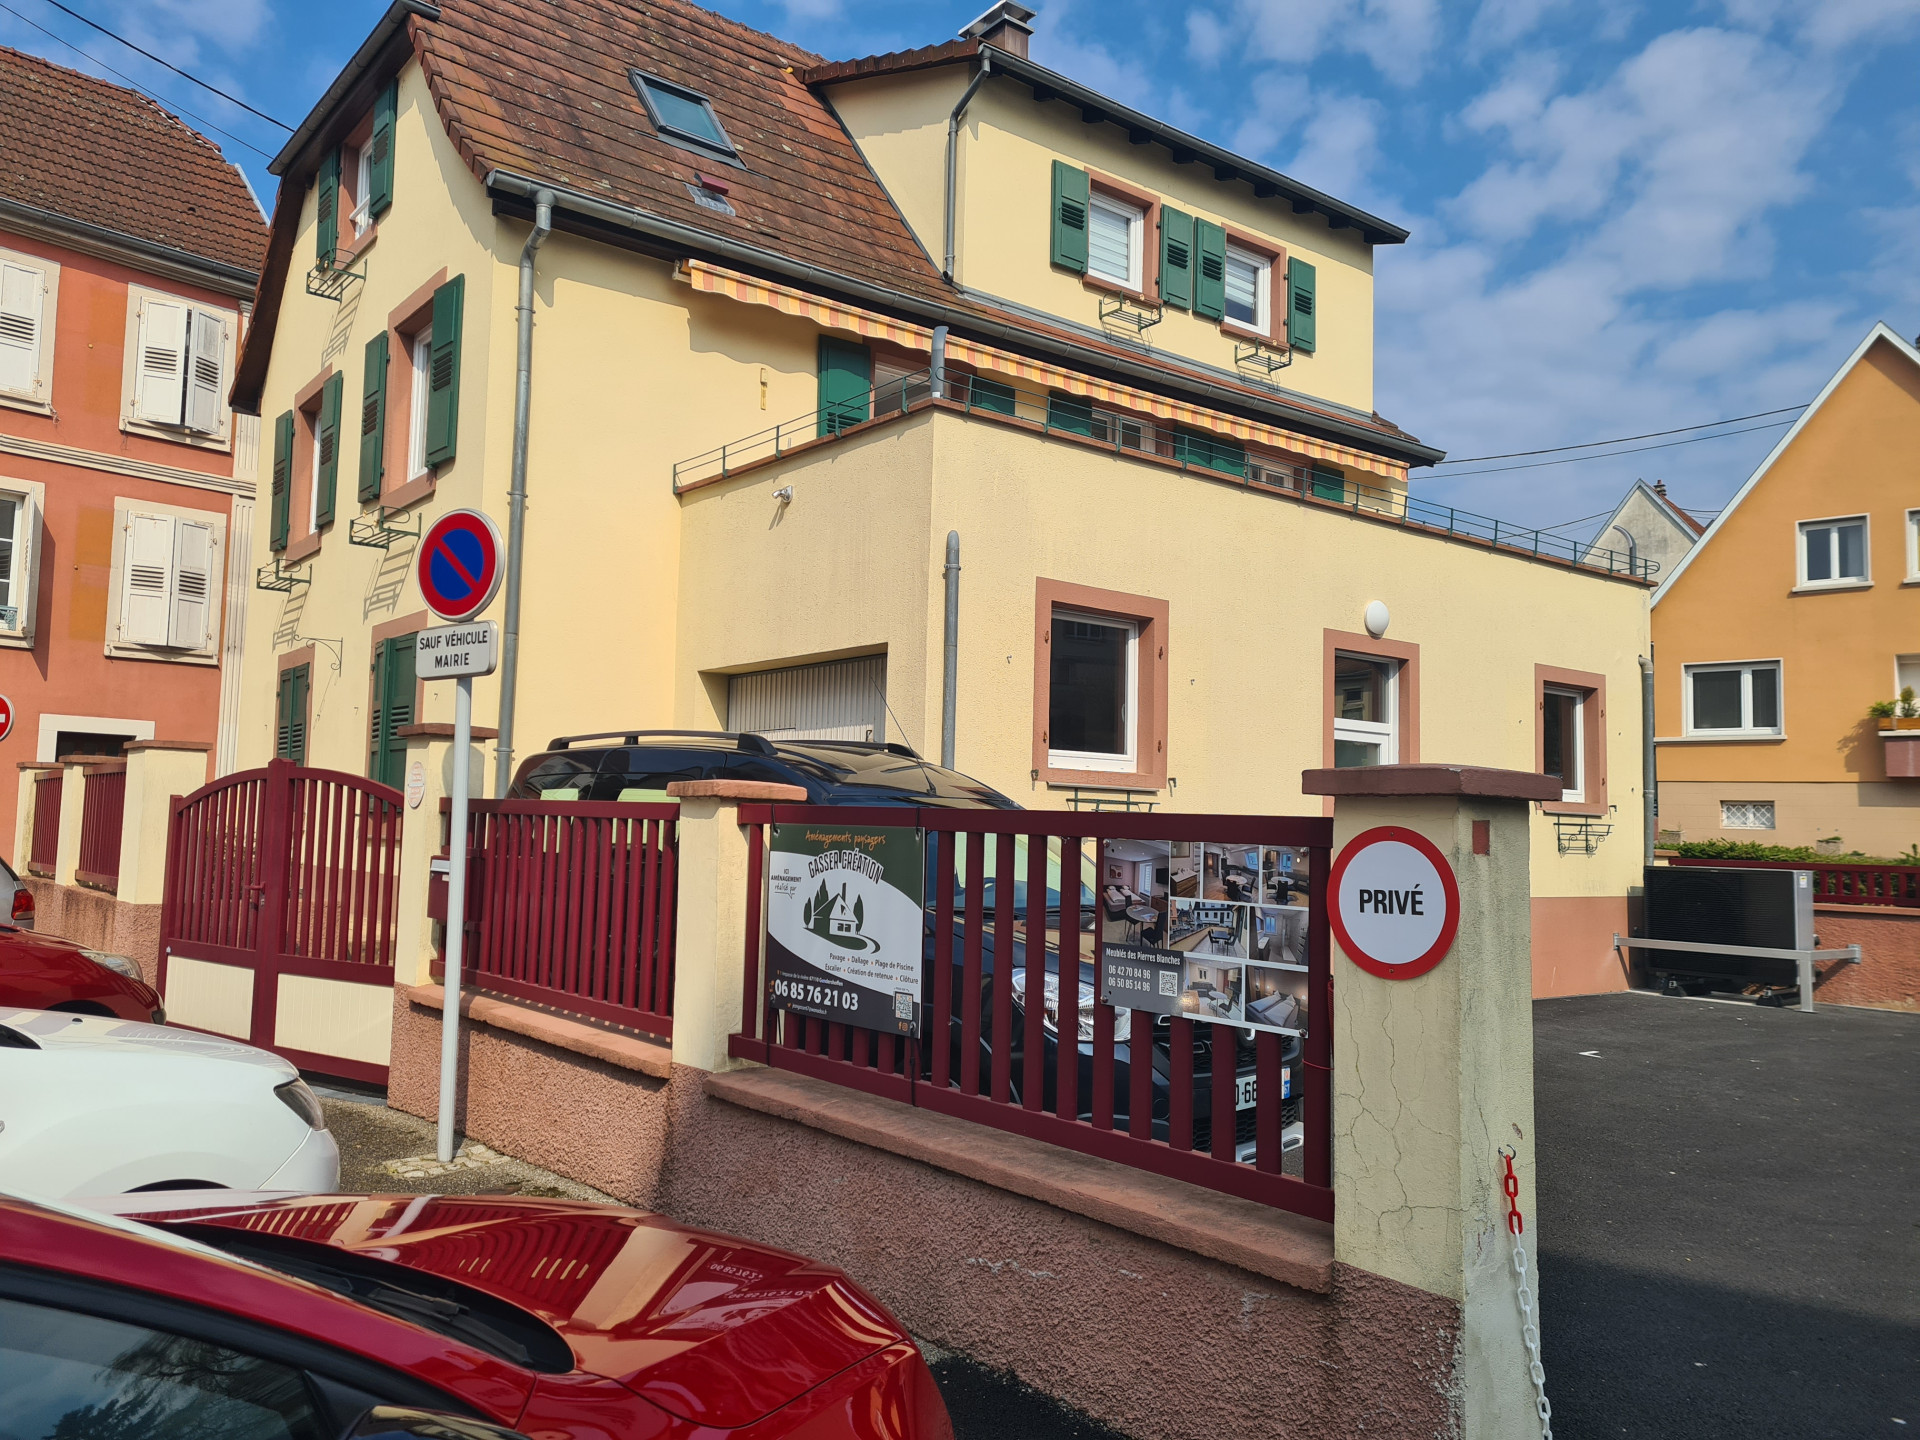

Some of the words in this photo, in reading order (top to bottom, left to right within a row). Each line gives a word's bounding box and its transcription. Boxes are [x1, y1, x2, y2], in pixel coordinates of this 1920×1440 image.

[420, 635, 442, 650] SAUF
[445, 630, 488, 647] VÉHICULE
[435, 653, 469, 668] MAIRIE
[806, 830, 851, 848] Aménagements
[854, 834, 885, 851] paysagers
[808, 852, 839, 878] GASSER
[842, 849, 882, 884] CRÉATION
[1360, 884, 1424, 915] PRIVÉ
[830, 953, 845, 962] Pavage
[851, 956, 868, 966] Dallage
[875, 960, 888, 969] Plage
[897, 963, 913, 971] Piscine
[1106, 948, 1126, 958] Meublés
[1128, 950, 1136, 959] des
[1138, 952, 1155, 962] Pierres
[1157, 954, 1180, 965] Blanches
[825, 964, 841, 972] Escalier
[847, 967, 866, 976] Création
[875, 972, 893, 980] retenue
[900, 975, 918, 984] Clôture
[1109, 965, 1116, 974] 06
[1118, 966, 1124, 976] 42
[1126, 967, 1132, 977] 70
[1134, 969, 1141, 978] 84
[1143, 970, 1150, 979] 96
[1109, 977, 1116, 986] 06
[1117, 978, 1124, 988] 50
[1126, 979, 1133, 989] 85
[1134, 981, 1141, 990] 14
[1143, 982, 1150, 991] 96
[775, 979, 788, 996] 06
[790, 982, 804, 1000] 85
[807, 986, 821, 1003] 76
[824, 990, 838, 1007] 21
[842, 994, 858, 1010] 03
